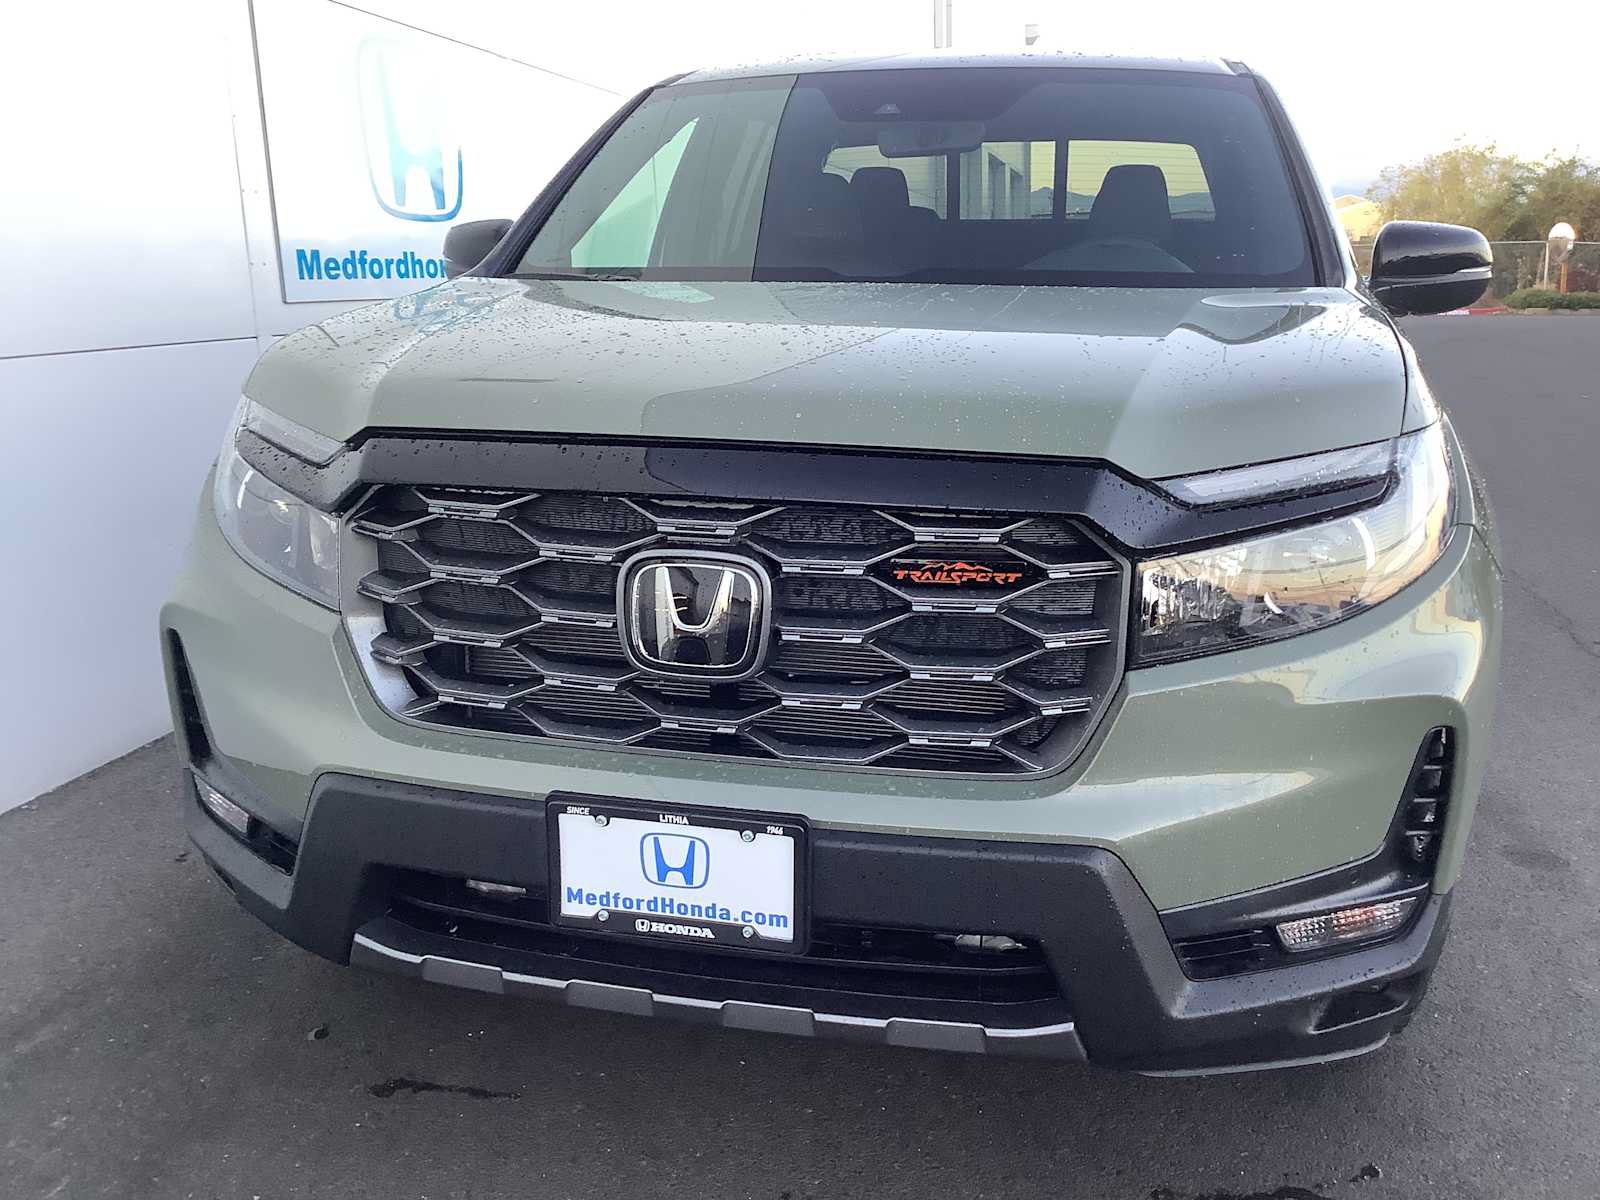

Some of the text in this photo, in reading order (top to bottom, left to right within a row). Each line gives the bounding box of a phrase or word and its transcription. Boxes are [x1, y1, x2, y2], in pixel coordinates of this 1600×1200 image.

[894, 570, 1022, 584] TRAILSPORT
[566, 806, 590, 815] SINCE
[659, 814, 689, 825] LITHIA
[566, 887, 788, 928] MedfordHonda.com
[650, 922, 716, 939] HONDA
